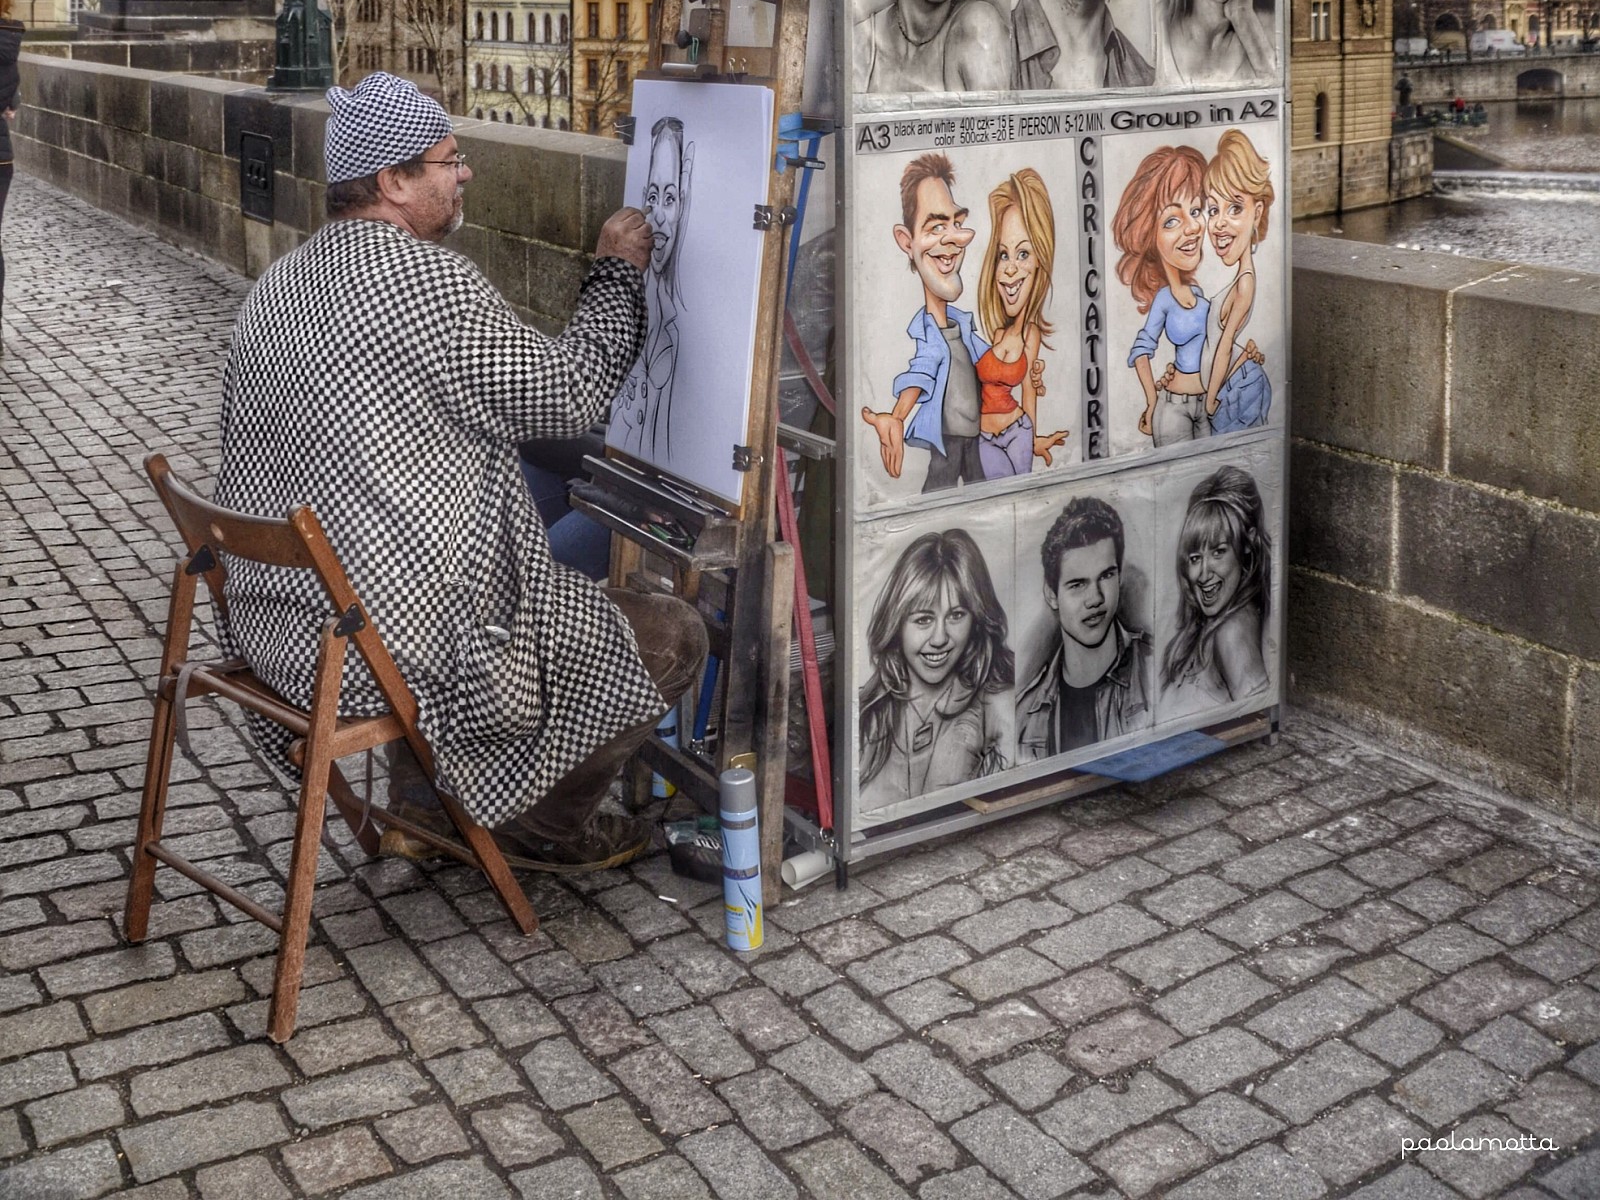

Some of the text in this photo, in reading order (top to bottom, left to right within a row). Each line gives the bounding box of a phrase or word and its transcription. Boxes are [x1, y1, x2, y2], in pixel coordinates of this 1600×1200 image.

[893, 121, 916, 136] black
[917, 120, 933, 135] and
[934, 118, 956, 134] white
[959, 116, 975, 131] 400
[997, 114, 1007, 129] 15
[1008, 113, 1015, 128] E
[1017, 112, 1106, 137] /PERSON 5-12 MIN.
[1110, 99, 1275, 130] Group in A2
[858, 124, 891, 150] A3
[934, 133, 956, 147] color
[1008, 128, 1015, 141] E
[1079, 136, 1102, 460] CARICATURE
